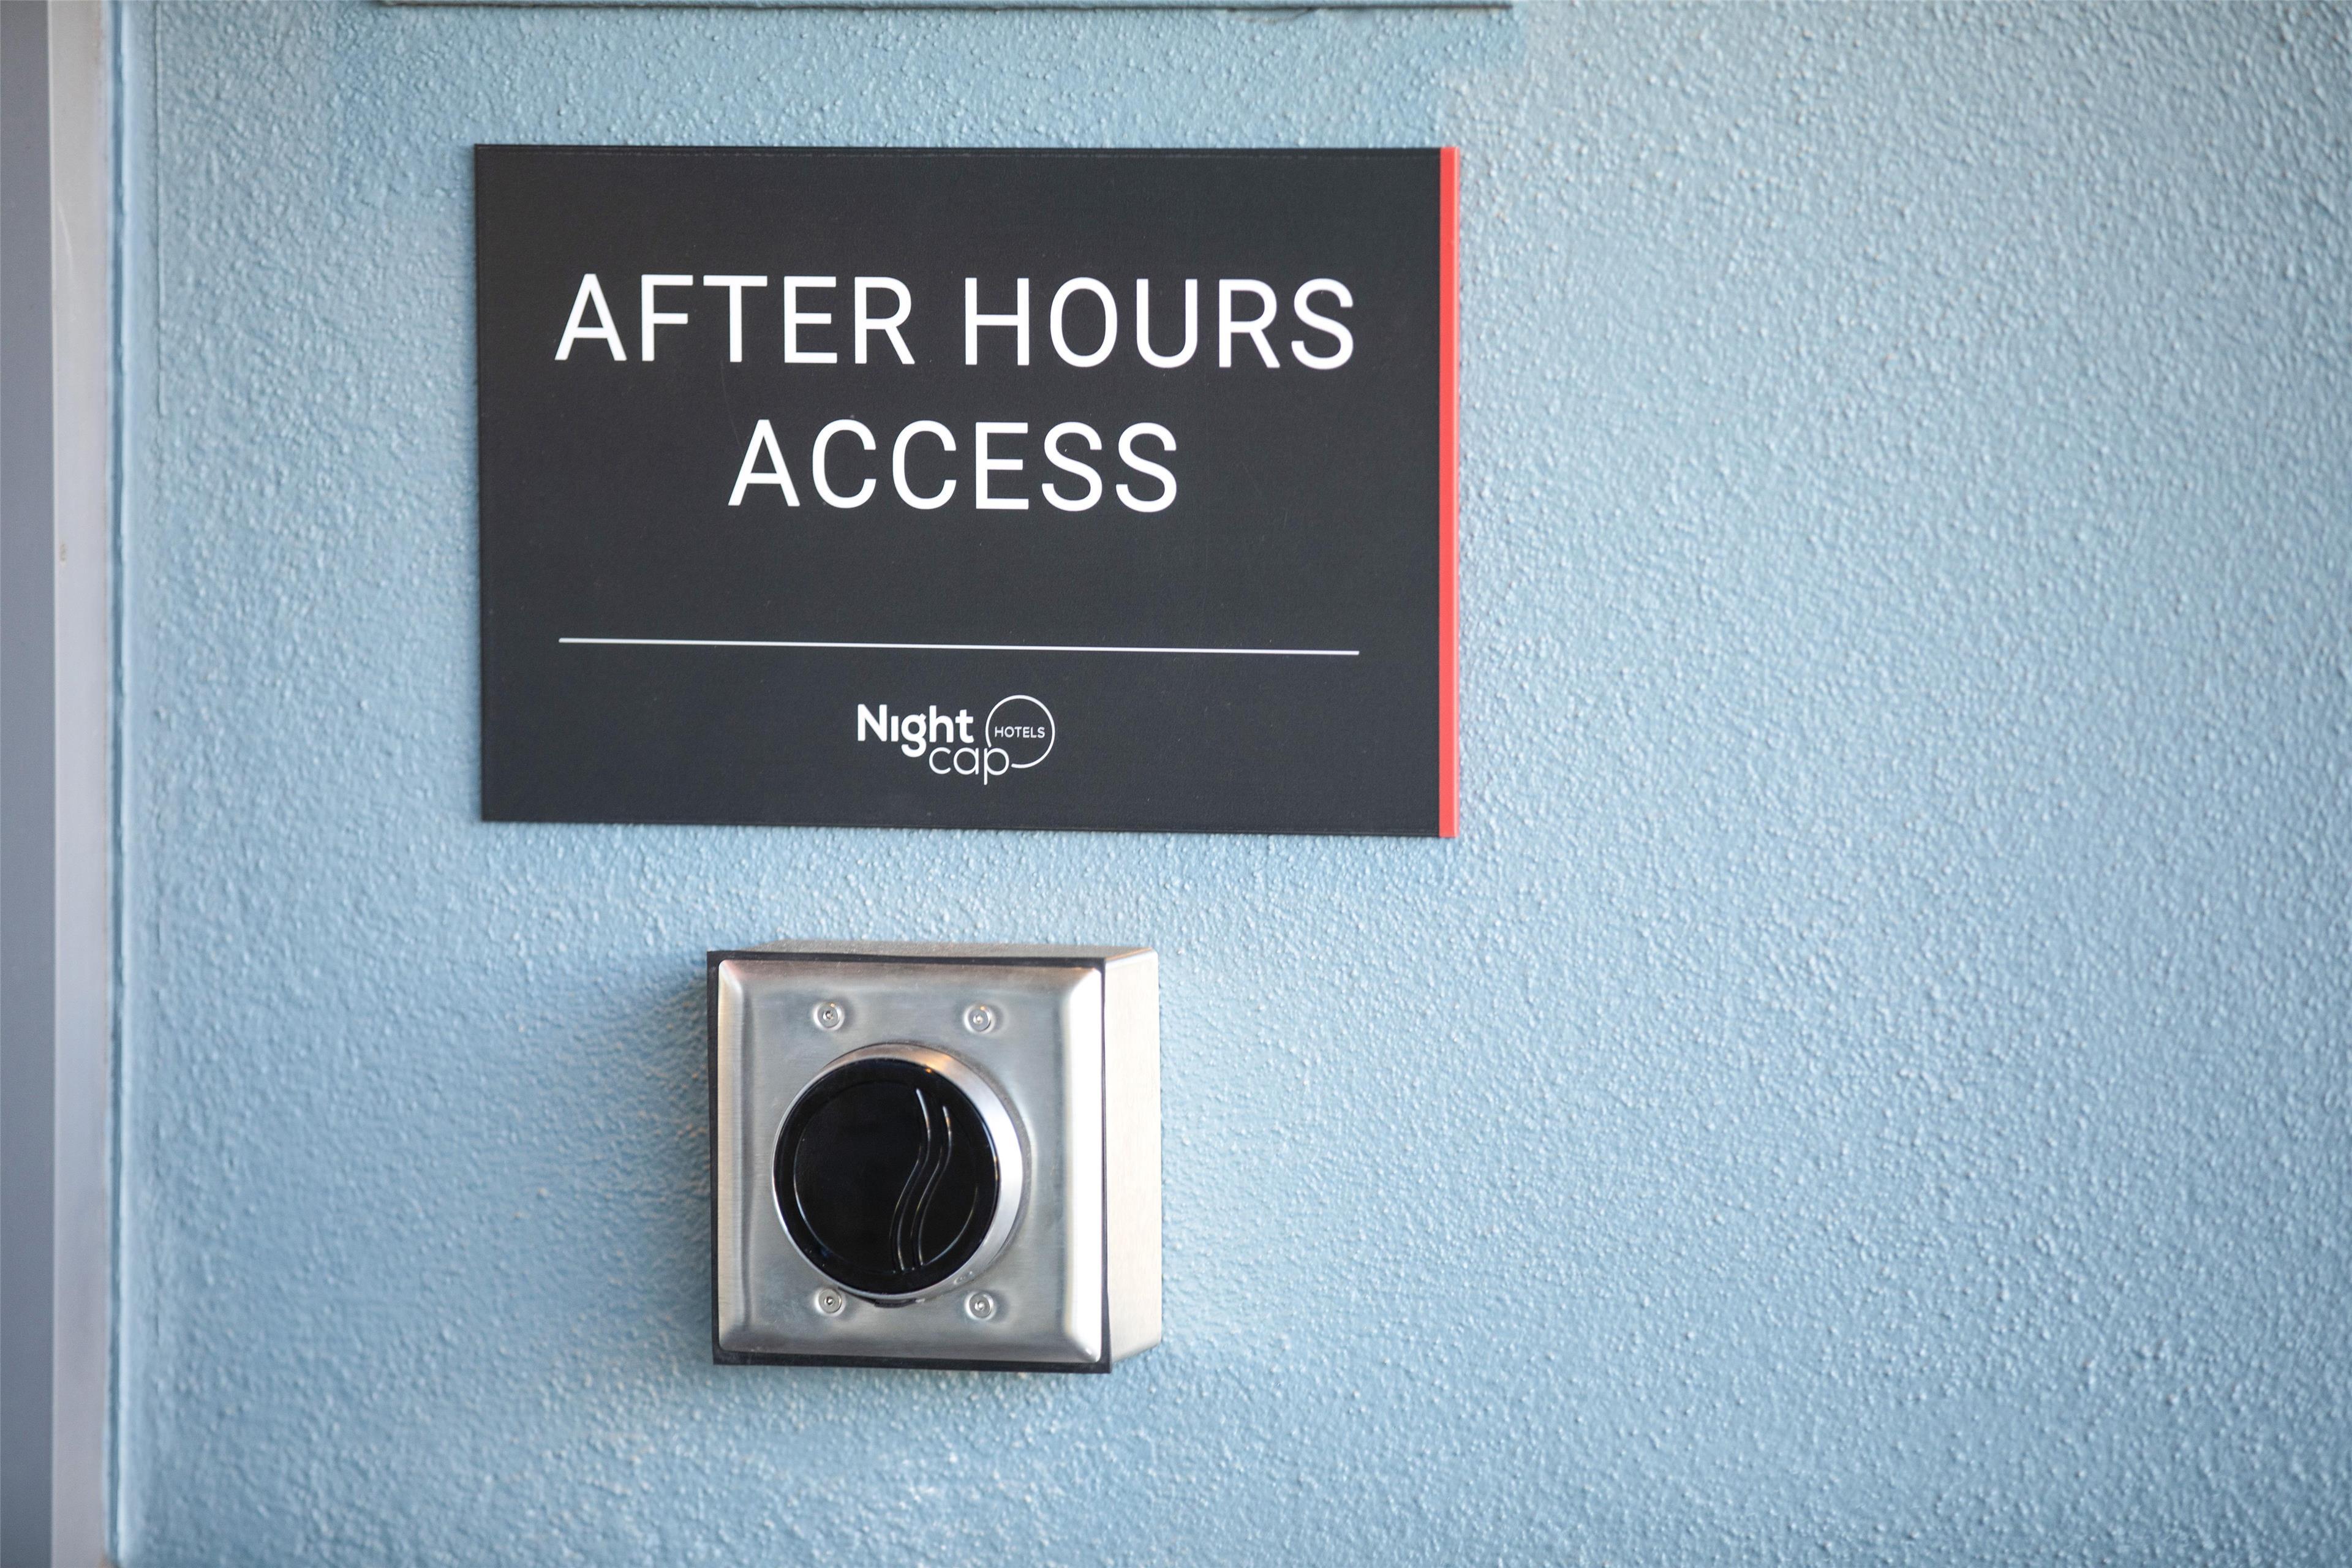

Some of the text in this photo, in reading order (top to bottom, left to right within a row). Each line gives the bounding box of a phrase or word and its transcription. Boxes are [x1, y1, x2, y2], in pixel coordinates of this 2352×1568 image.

[554, 273, 1354, 370] AFTER HOURS
[728, 419, 1177, 513] ACCESS
[857, 703, 975, 758] Night
[994, 726, 1046, 739] HOTELS
[929, 747, 1010, 786] cap
